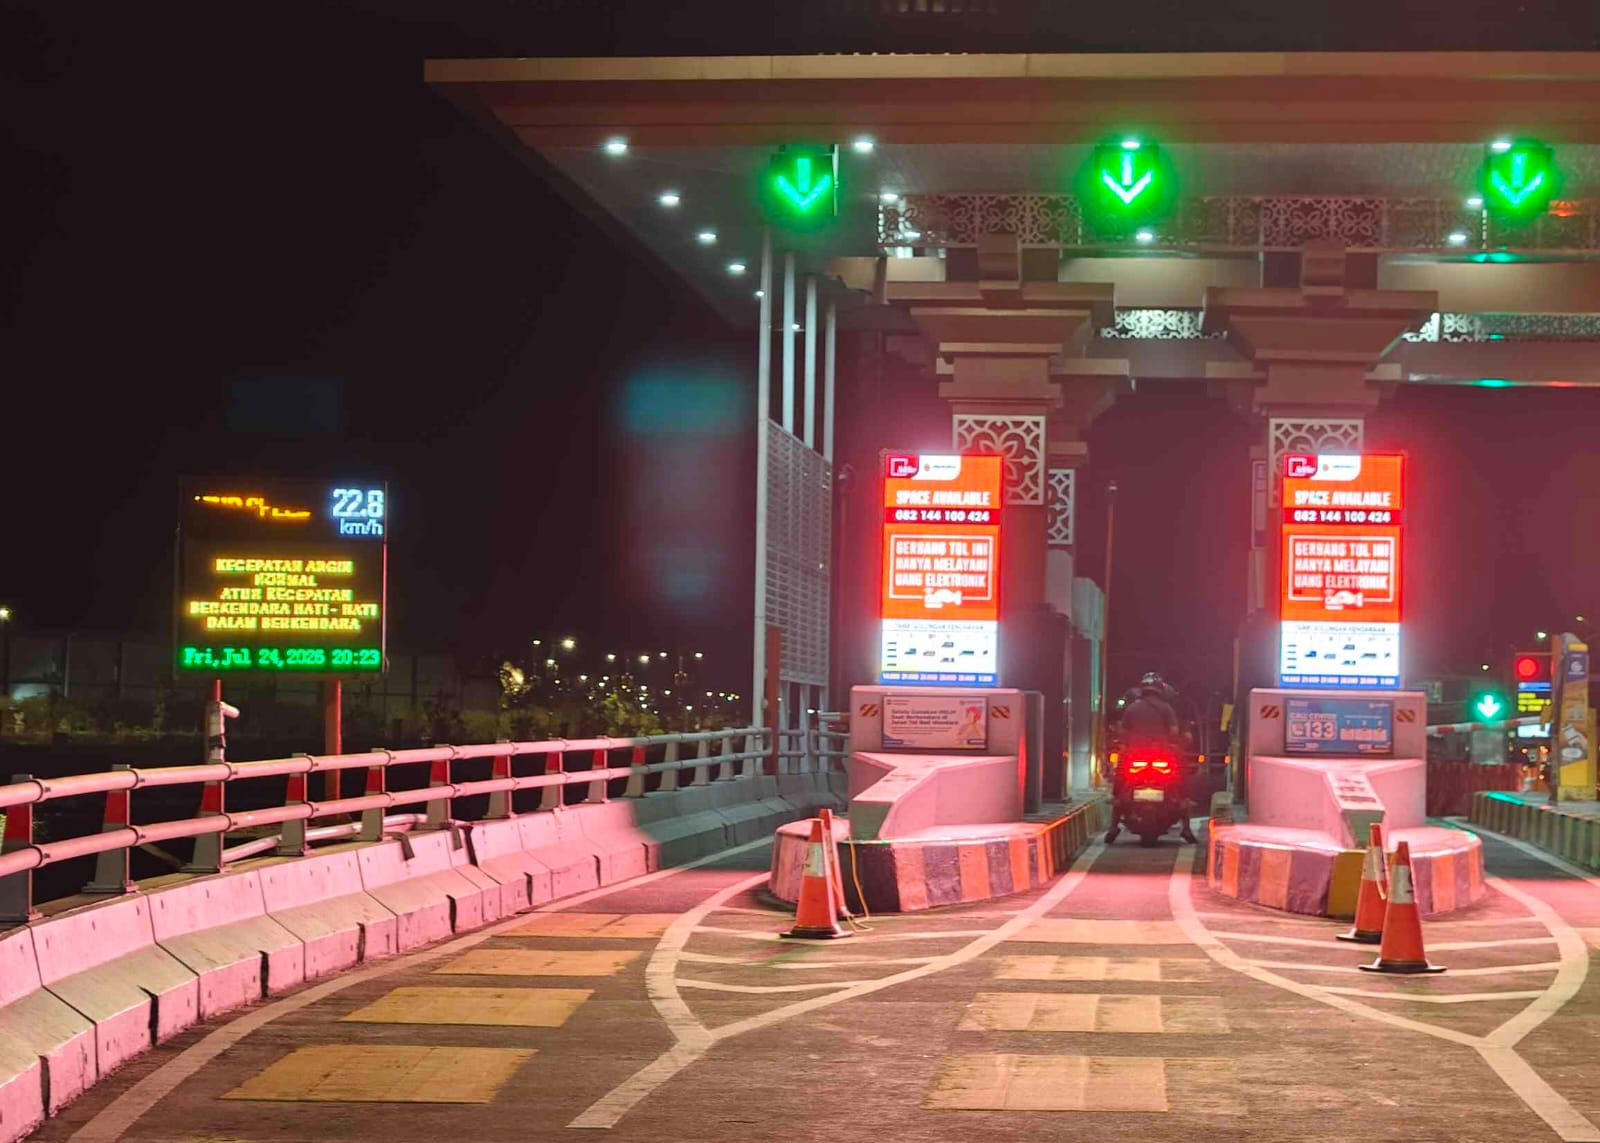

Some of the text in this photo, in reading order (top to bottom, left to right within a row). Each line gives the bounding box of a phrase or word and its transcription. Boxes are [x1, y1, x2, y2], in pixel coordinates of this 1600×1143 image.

[332, 488, 385, 517] 22.8
[896, 490, 990, 505] SPACE AVAILABLE
[1295, 490, 1391, 506] SPACE AVAILABLE
[921, 510, 941, 521] 144
[967, 511, 989, 522] 424
[1320, 510, 1341, 521] 144
[1368, 511, 1391, 522] 424
[340, 518, 384, 535] km/h
[896, 541, 988, 555] GERBANG TOL INI
[1295, 542, 1389, 557] GERBANG TOL INI
[215, 559, 303, 572] KECEPATAN
[896, 558, 987, 571] HANYA MELAYANI
[1295, 558, 1388, 572] HANYA MELAYANI
[896, 573, 986, 587] UANG ELEKTRONIK
[1295, 574, 1387, 589] UANG ELEKTRONIK
[220, 588, 353, 601] ATUR KECEPATAN
[342, 603, 379, 616] HATI
[207, 616, 361, 630] DALAM BERKENDARA
[331, 648, 381, 665] 20:23
[1304, 720, 1334, 738] 133
